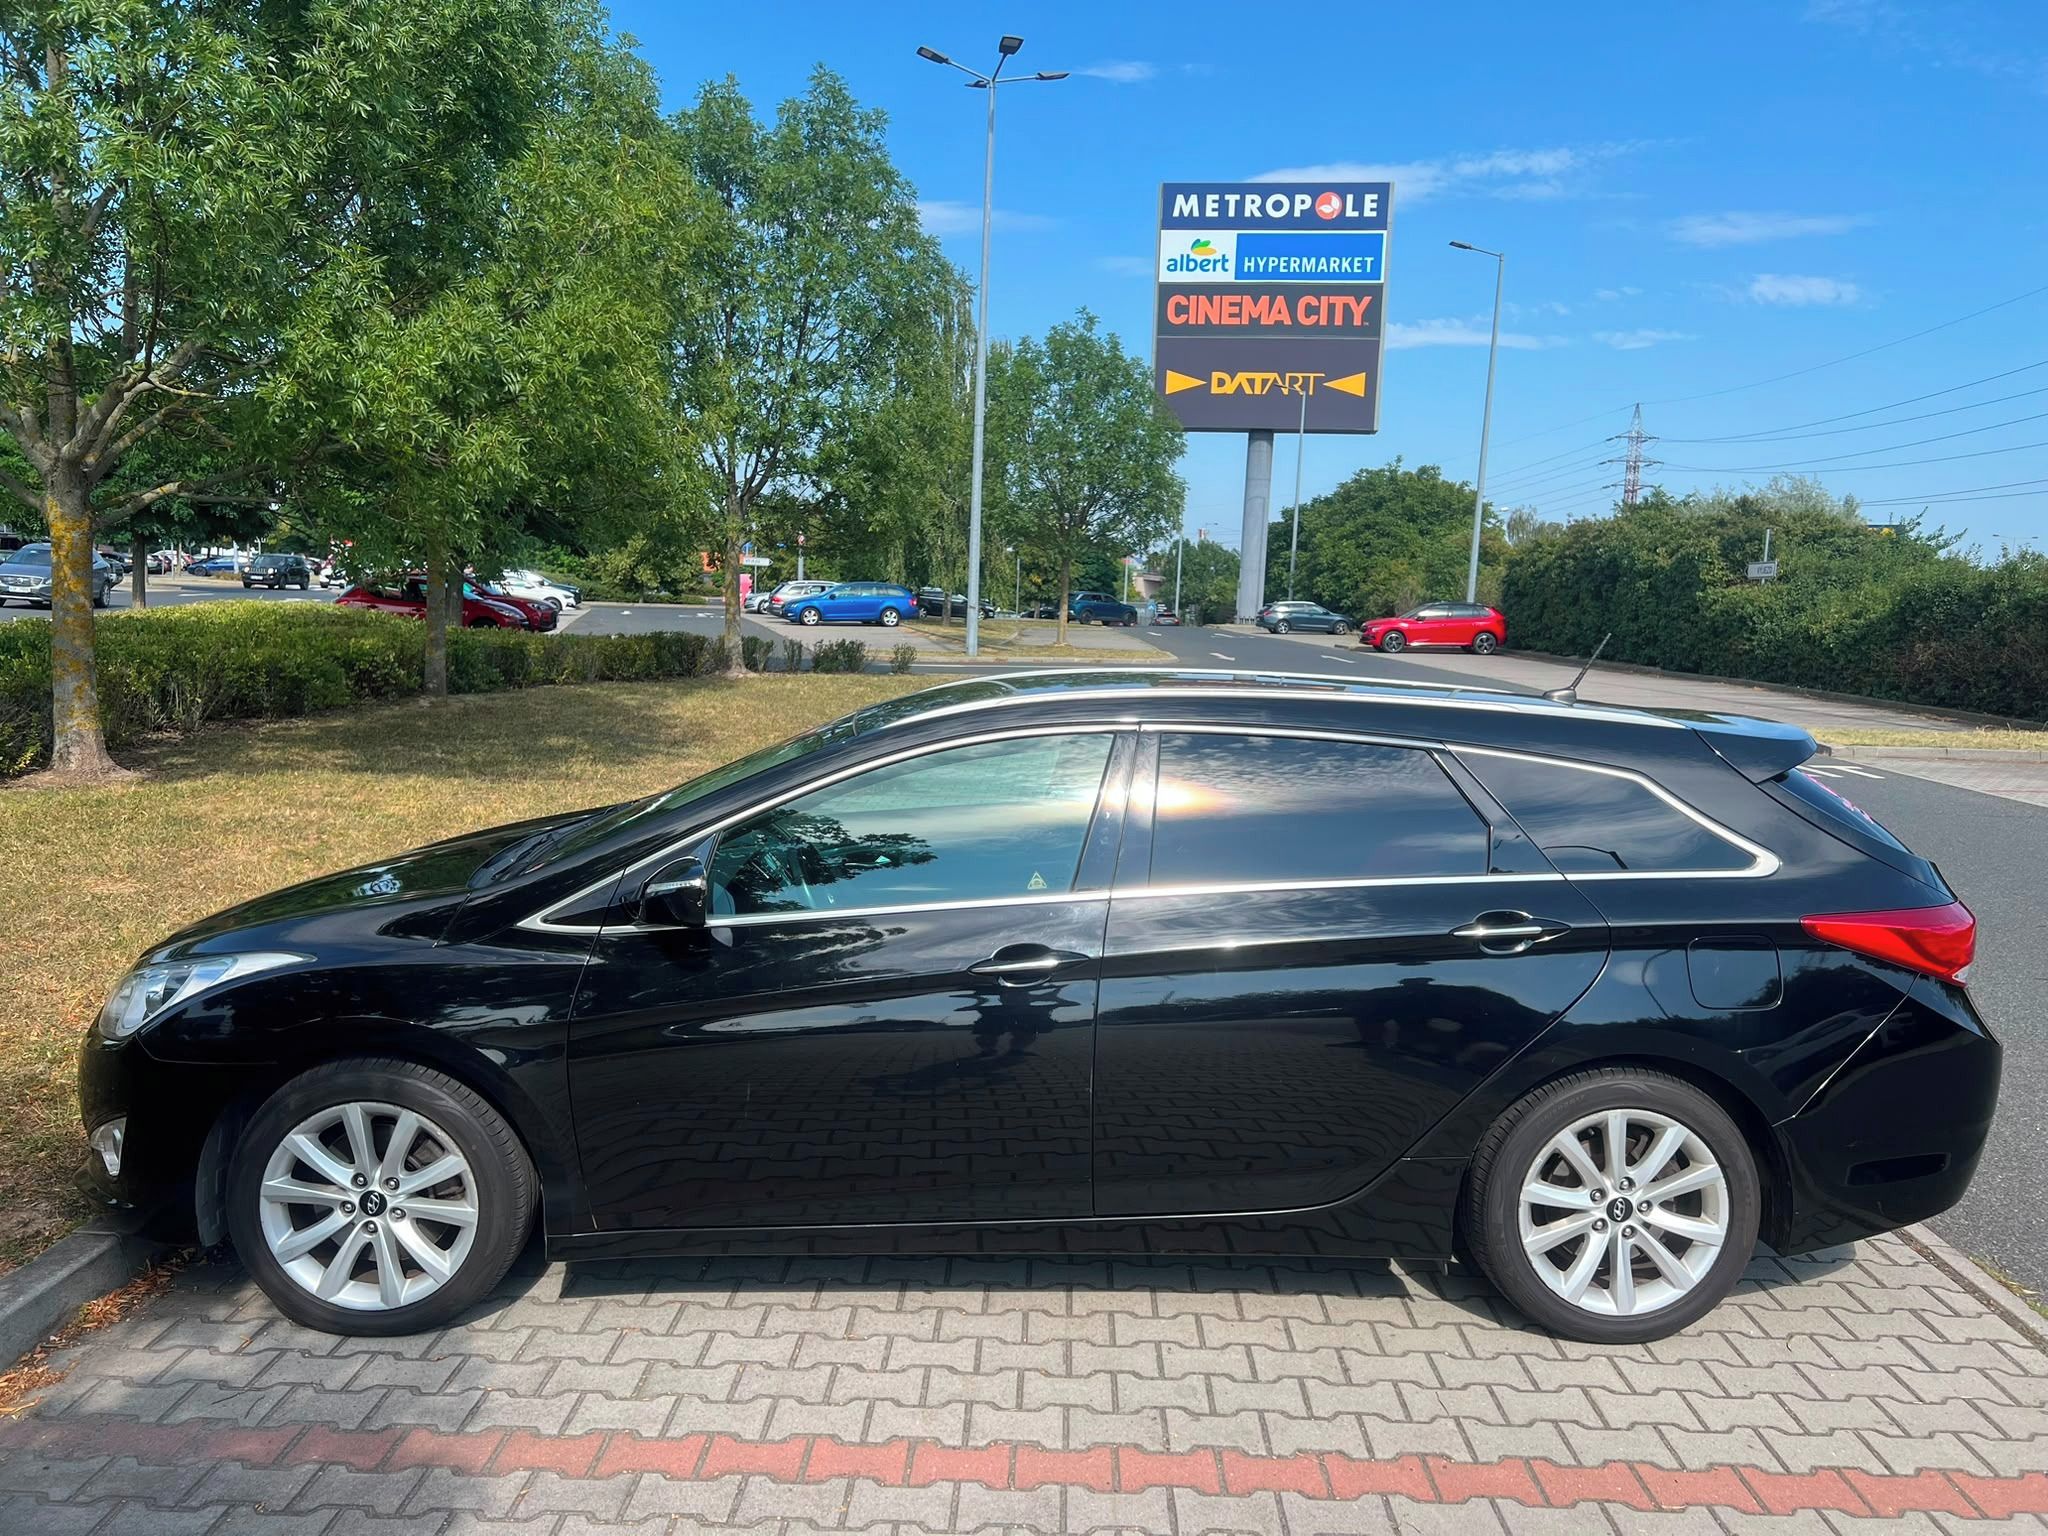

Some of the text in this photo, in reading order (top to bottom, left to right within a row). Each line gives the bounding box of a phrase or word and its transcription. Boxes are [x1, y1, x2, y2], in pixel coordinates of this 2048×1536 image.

[1172, 191, 1379, 221] METROPOLE
[1166, 254, 1229, 273] albert
[1243, 256, 1375, 273] HYPERMARKET
[1166, 294, 1373, 327] CINEMA CITY
[1210, 371, 1326, 396] DATART
